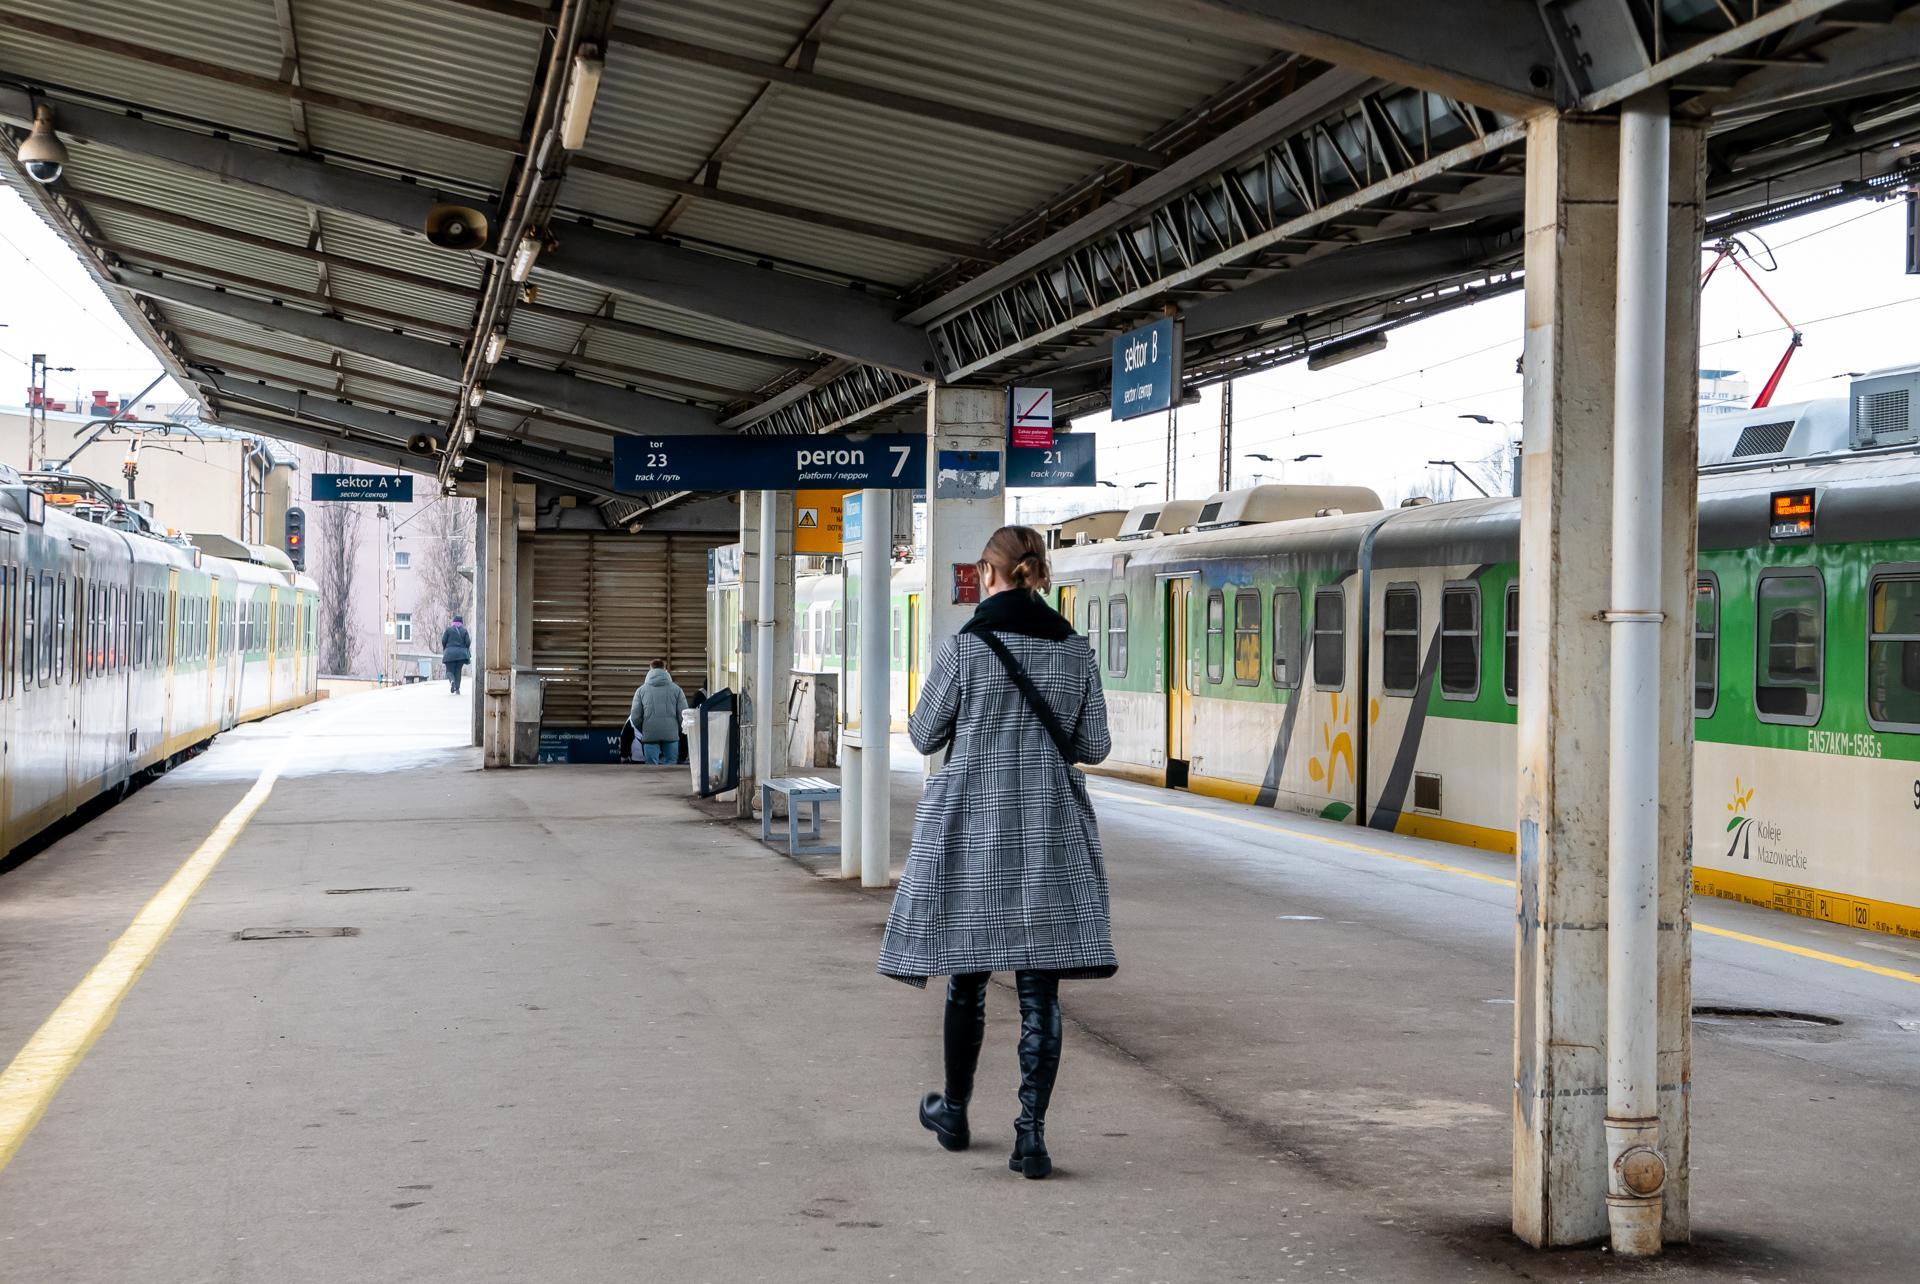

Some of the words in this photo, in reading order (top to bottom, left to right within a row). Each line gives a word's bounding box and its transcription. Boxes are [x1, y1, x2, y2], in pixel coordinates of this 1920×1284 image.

[1125, 337, 1148, 372] sektor
[1151, 330, 1158, 363] B
[647, 453, 668, 467] 23
[797, 449, 864, 470] peron
[889, 446, 911, 477] 7
[1043, 450, 1062, 464] 21
[336, 476, 374, 488] sektor
[378, 477, 388, 488] A
[635, 473, 654, 481] track
[799, 472, 832, 480] platform
[1807, 730, 1875, 757] EN57AKM-1585
[1758, 821, 1782, 845] Koleje
[1758, 847, 1808, 869] Mazowieckie
[1820, 900, 1829, 917] PL
[1855, 906, 1867, 925] 120
